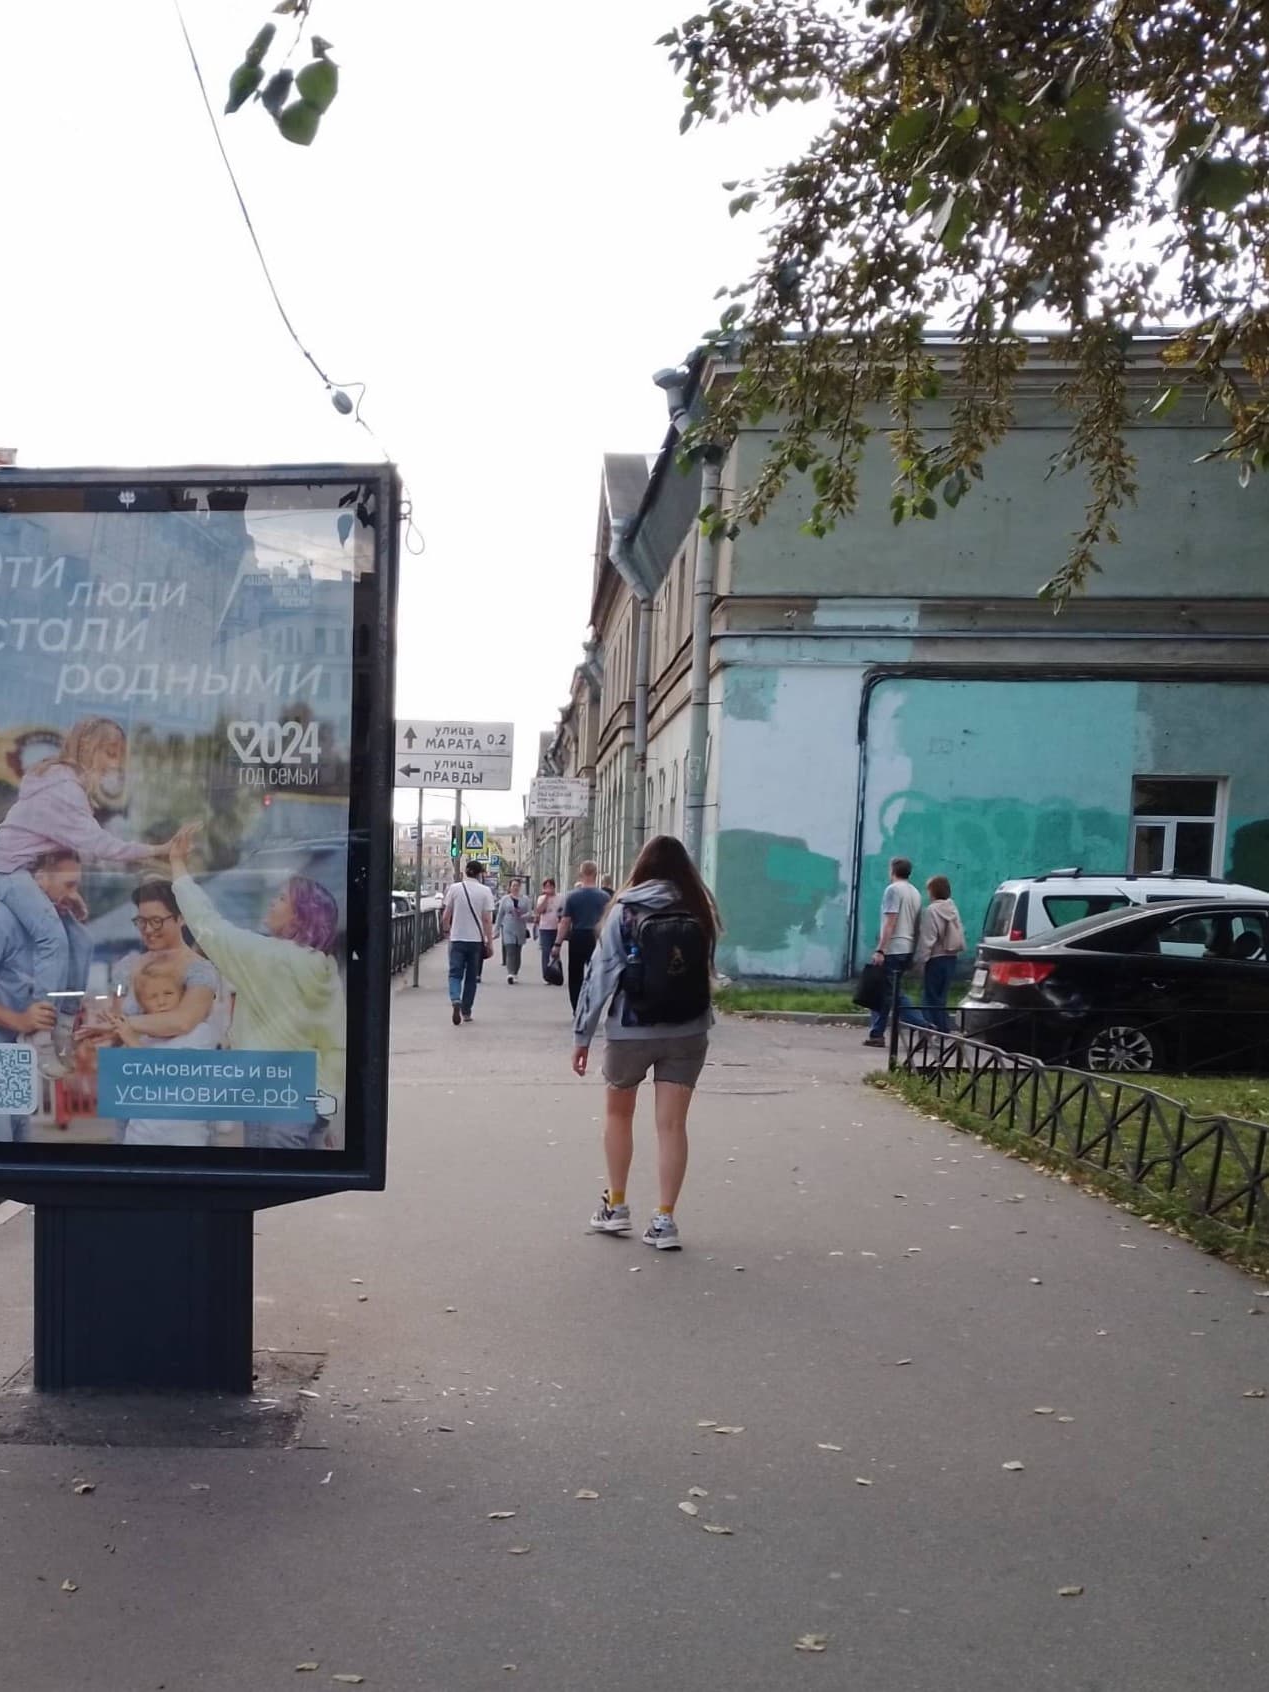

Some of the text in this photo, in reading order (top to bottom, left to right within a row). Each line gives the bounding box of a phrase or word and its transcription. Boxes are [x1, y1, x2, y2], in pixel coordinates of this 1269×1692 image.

[67, 581, 188, 612] люди
[54, 662, 324, 705] родными
[435, 727, 474, 737] улица
[229, 721, 322, 764] 2024
[425, 738, 481, 750] МАРАТА
[434, 760, 474, 770] улица
[423, 771, 483, 784] ПРАВДЫ
[122, 1063, 292, 1079] СТАНОВИТЕСЬ И ВЫ
[115, 1084, 299, 1107] усыновите.рф
